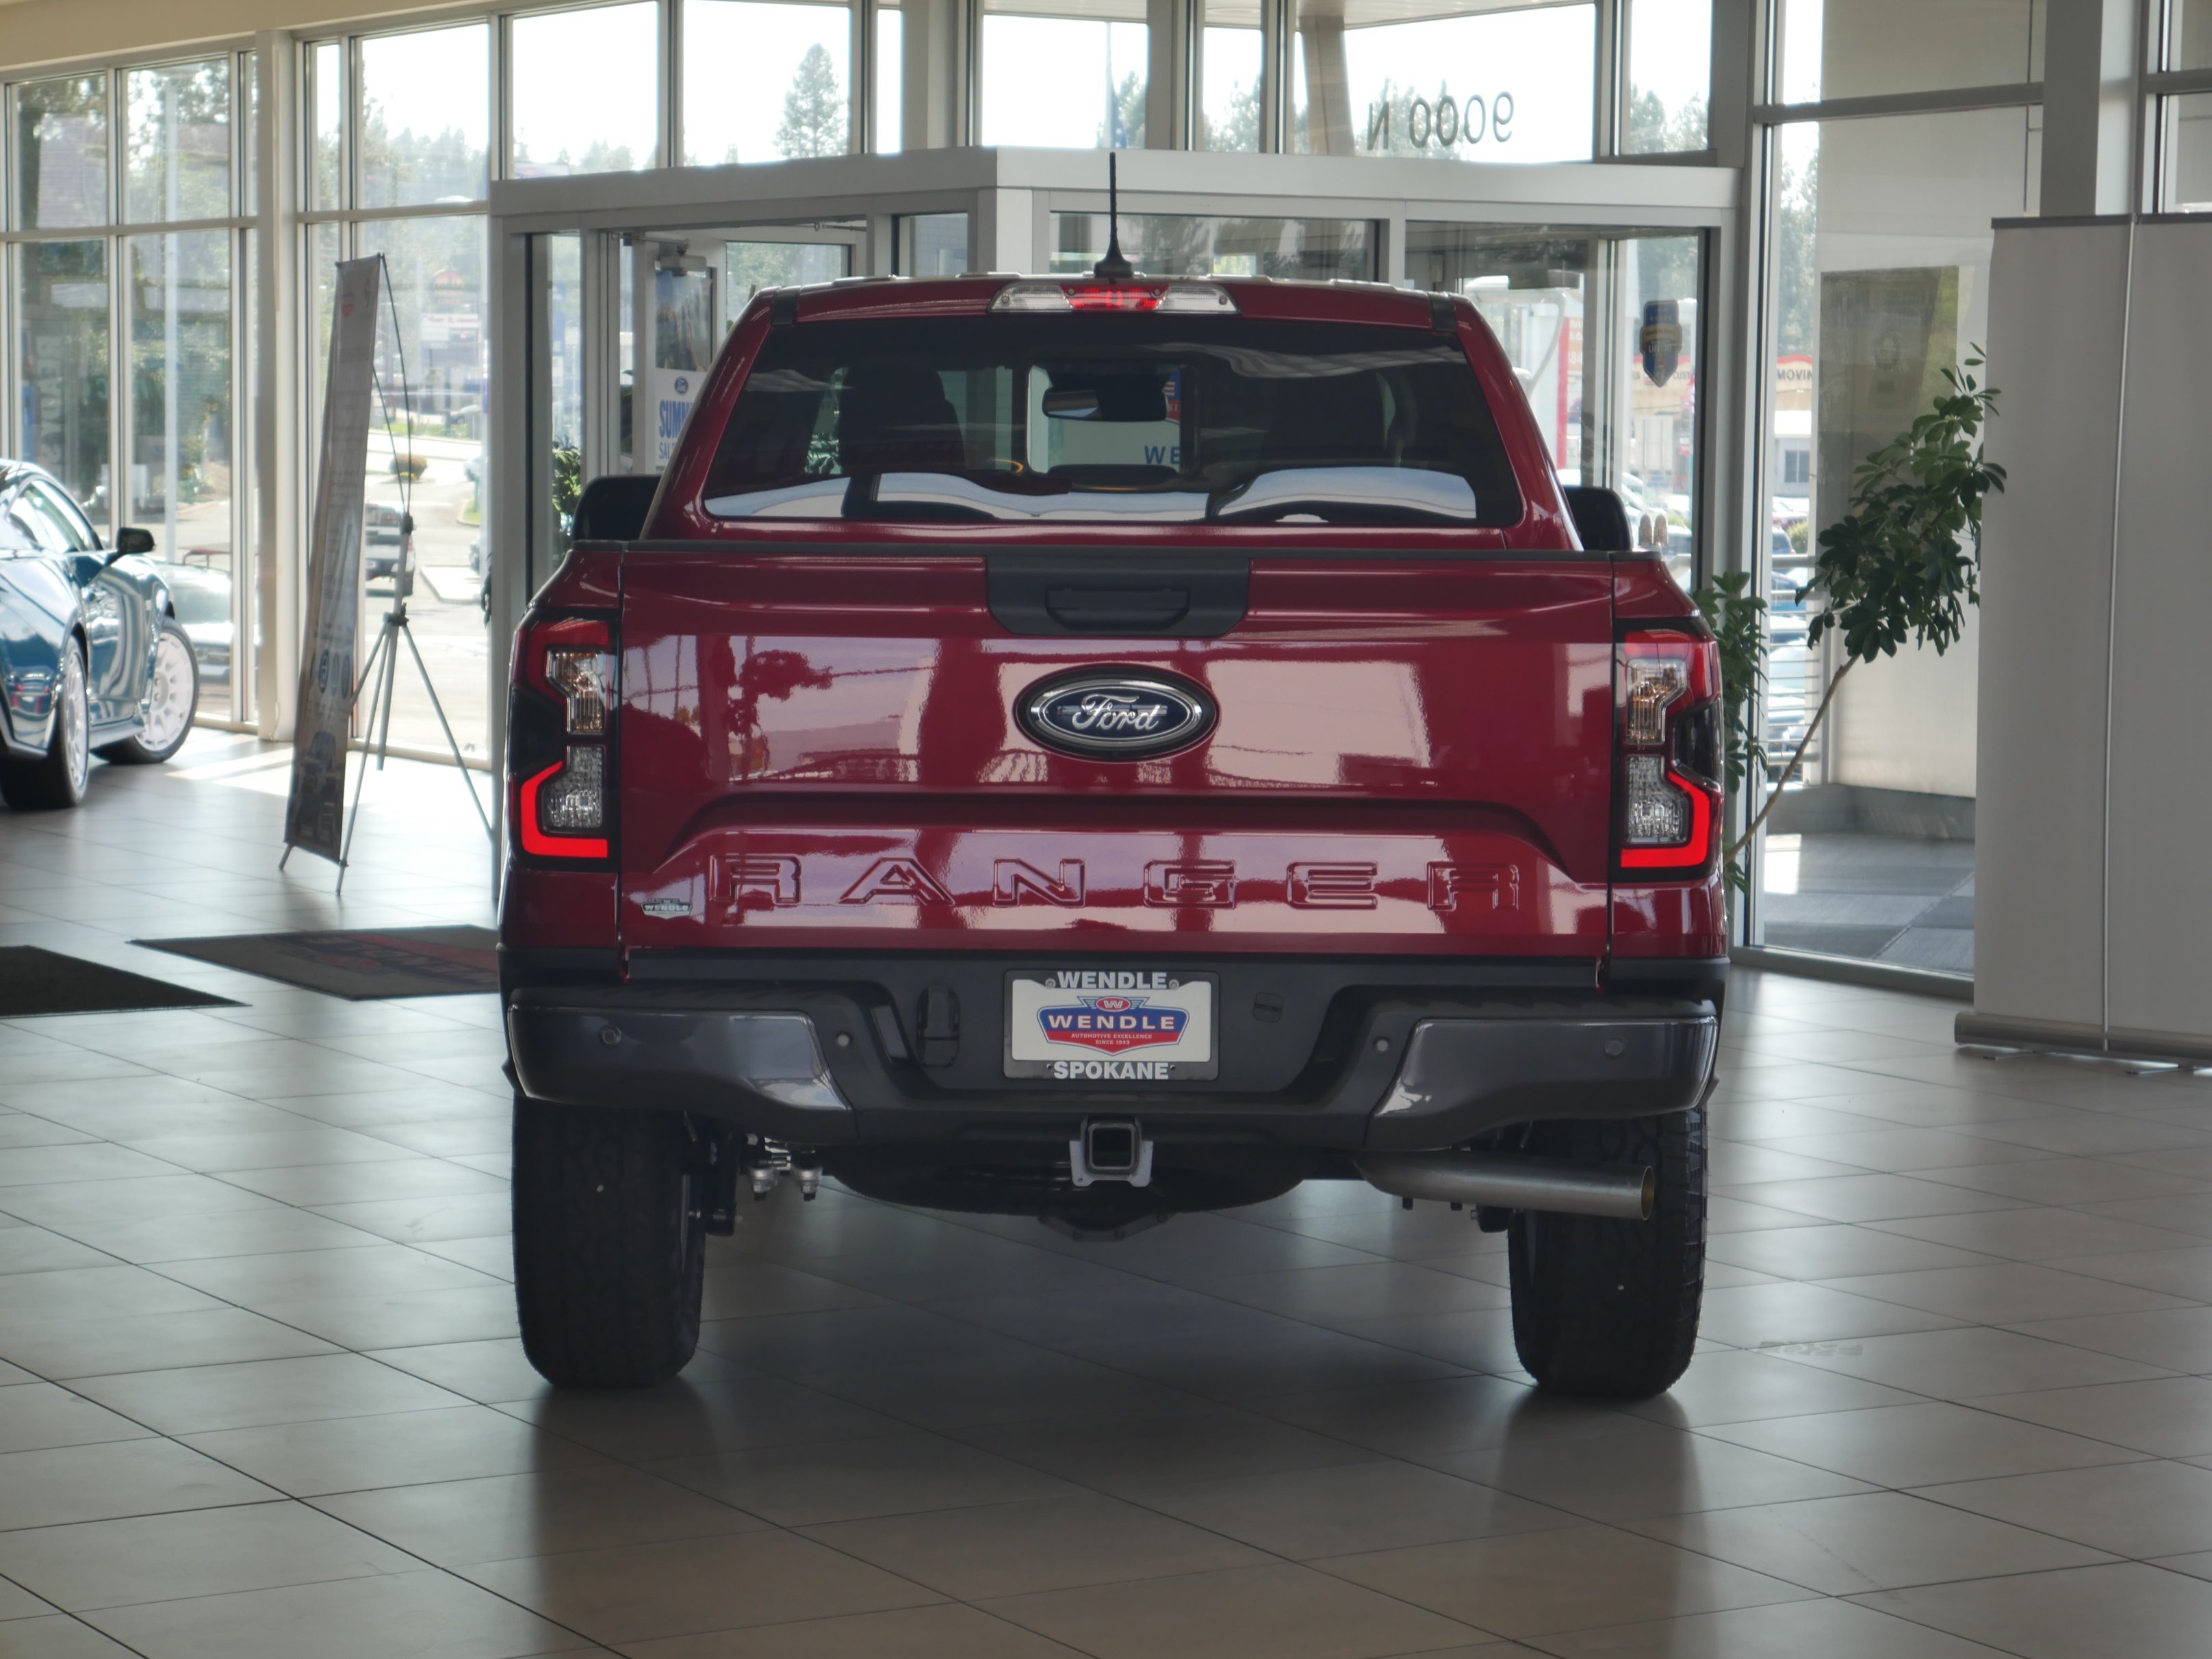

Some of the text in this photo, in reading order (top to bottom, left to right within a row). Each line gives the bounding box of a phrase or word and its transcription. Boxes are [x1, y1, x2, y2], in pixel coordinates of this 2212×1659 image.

[1072, 693, 1161, 730] Ford
[709, 853, 1519, 910] RANGER
[1057, 971, 1168, 990] WENDLE
[1048, 1014, 1174, 1030] WENDLE
[1053, 1061, 1168, 1080] SPOKANE
